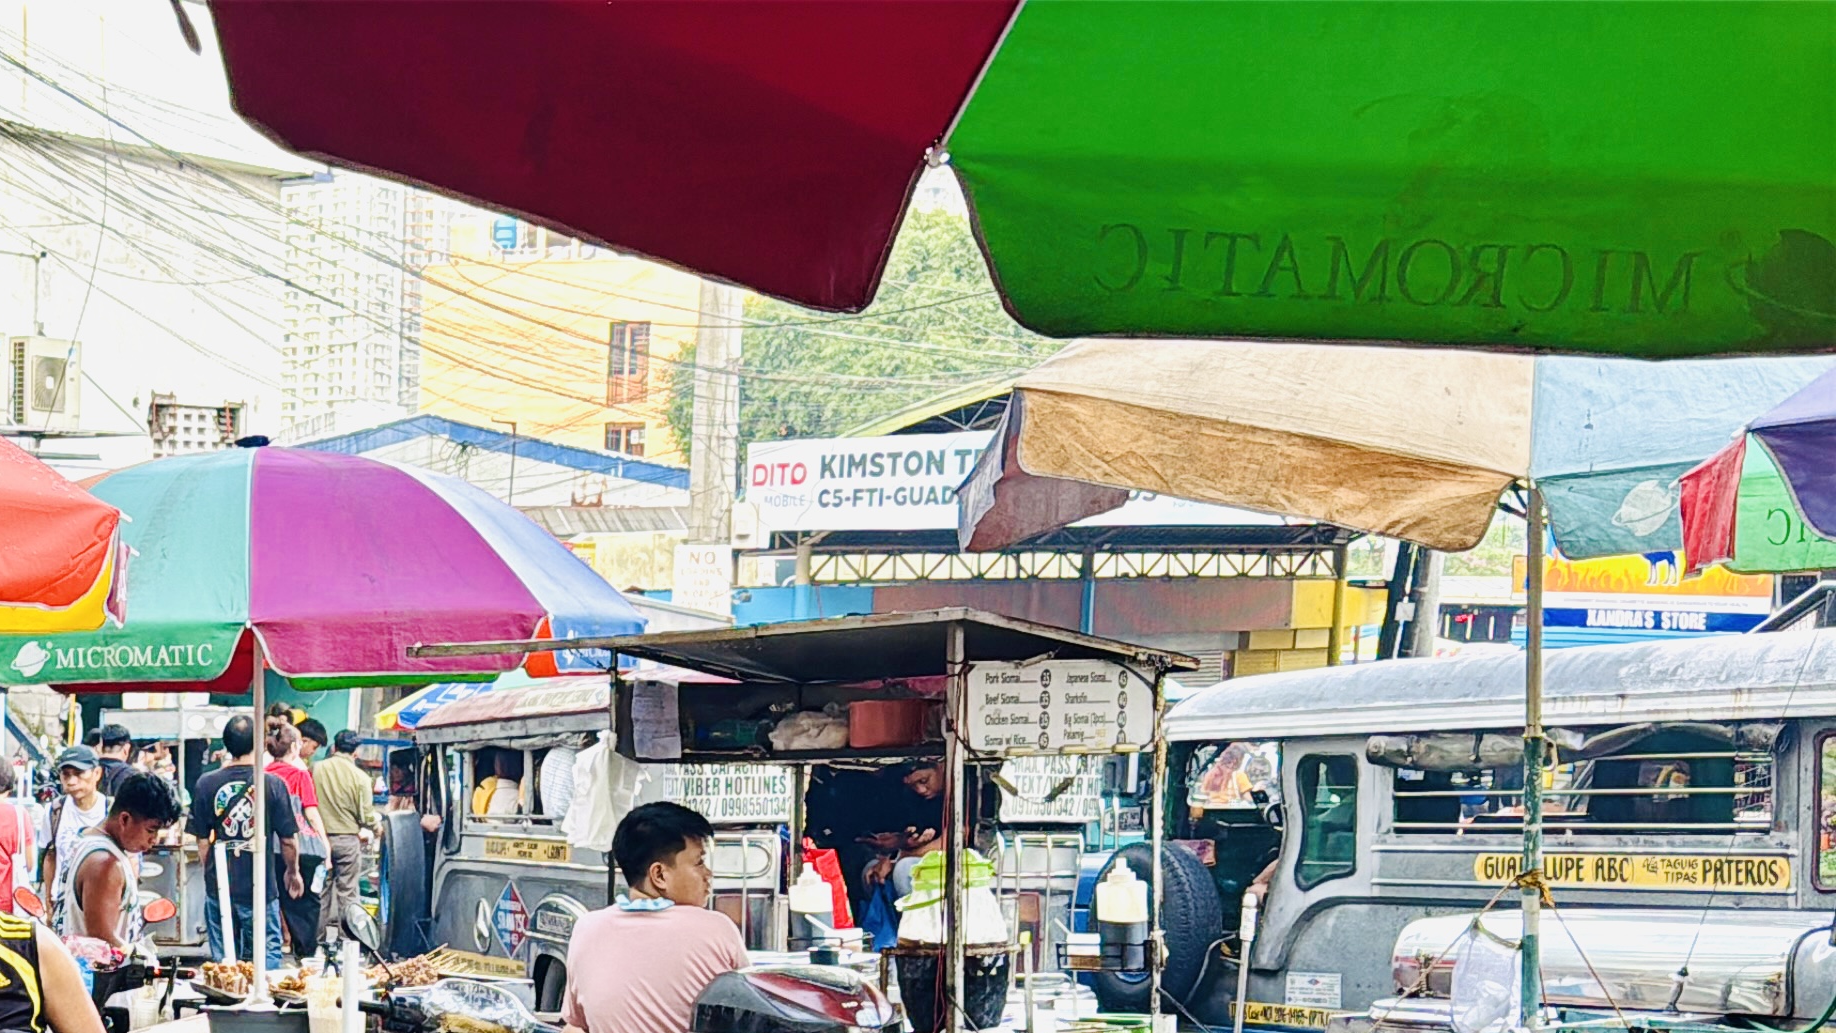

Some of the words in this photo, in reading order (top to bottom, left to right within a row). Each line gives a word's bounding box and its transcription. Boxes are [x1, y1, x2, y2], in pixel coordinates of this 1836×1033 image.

[752, 462, 807, 487] DITO
[820, 450, 944, 479] KIMSTON
[1586, 608, 1654, 629] XANDRA'S
[1661, 611, 1707, 630] STORE
[55, 643, 213, 669] MICROMATIC
[985, 673, 999, 684] Pork
[1001, 672, 1021, 684] Siomai
[985, 693, 999, 705] Beef
[1000, 692, 1020, 705] Siomai
[984, 713, 1009, 725] Chicken
[1010, 712, 1029, 725] Siomai
[984, 734, 1003, 746] Siomai
[725, 775, 787, 796] HOTLINES
[1484, 855, 1585, 882] GUALUPE
[1592, 856, 1634, 882] (ABC)
[1659, 858, 1698, 870] TAGUIG
[1702, 859, 1780, 886] PATEROS
[1664, 871, 1698, 884] TIPAS
